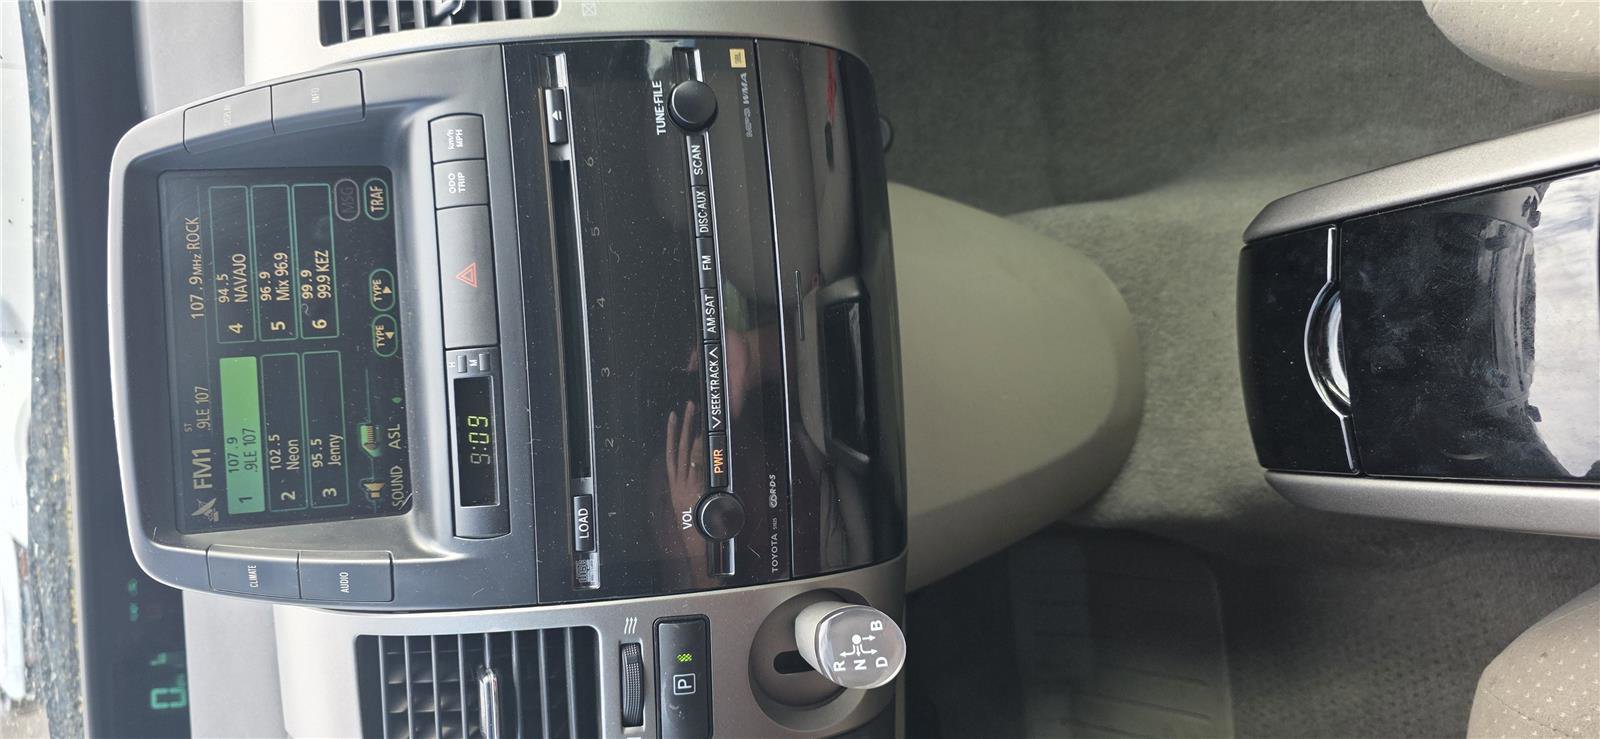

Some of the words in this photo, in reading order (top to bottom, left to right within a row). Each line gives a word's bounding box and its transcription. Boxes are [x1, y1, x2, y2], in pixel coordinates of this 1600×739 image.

[740, 72, 750, 104] WMA
[455, 128, 464, 148] MPH
[584, 156, 594, 166] 6
[692, 144, 704, 176] SCAN
[448, 172, 456, 194] ODO
[457, 172, 466, 193] TRIP
[370, 186, 384, 212] TRAF
[185, 216, 200, 250] ROCK
[591, 226, 600, 236] 5
[273, 252, 288, 276] 96.9
[314, 250, 330, 272] KEZ
[702, 255, 712, 271] FM
[216, 274, 230, 303] 94.5
[232, 253, 248, 303] NAVAJO
[258, 272, 272, 301] 96.9
[300, 270, 314, 299] 99.9
[316, 275, 332, 298] 99.9
[275, 280, 290, 301] Mix
[372, 279, 382, 302] TYPE
[596, 297, 606, 308] 4
[228, 322, 244, 334] 4
[271, 321, 286, 331] 5
[312, 319, 327, 329] 6
[375, 324, 385, 348] TYPE
[601, 367, 610, 377] 3
[194, 386, 209, 404] 107
[184, 422, 192, 432] ST
[242, 428, 256, 446] 107
[387, 424, 402, 449] ASL
[328, 434, 344, 466] Jenny
[467, 415, 490, 464] 9:09
[604, 438, 614, 448] 2
[226, 436, 240, 473] 107.9
[268, 434, 282, 470] 102.5
[286, 439, 300, 470] Neon
[310, 438, 324, 468] 95.5
[714, 448, 724, 474] PWR
[192, 448, 213, 489] FM1
[281, 491, 296, 500] 2
[322, 488, 337, 498] 3
[389, 465, 404, 507] SOUND
[238, 496, 252, 504] 1
[578, 508, 590, 538] LOAD
[682, 506, 692, 530] VOL
[770, 532, 778, 574] TOYOTA
[247, 564, 259, 588] CLIMATE
[339, 572, 350, 593] AUDIO
[870, 620, 883, 630] B
[834, 660, 846, 672] R
[854, 658, 867, 670] N
[875, 656, 888, 668] D
[677, 678, 692, 689] P
